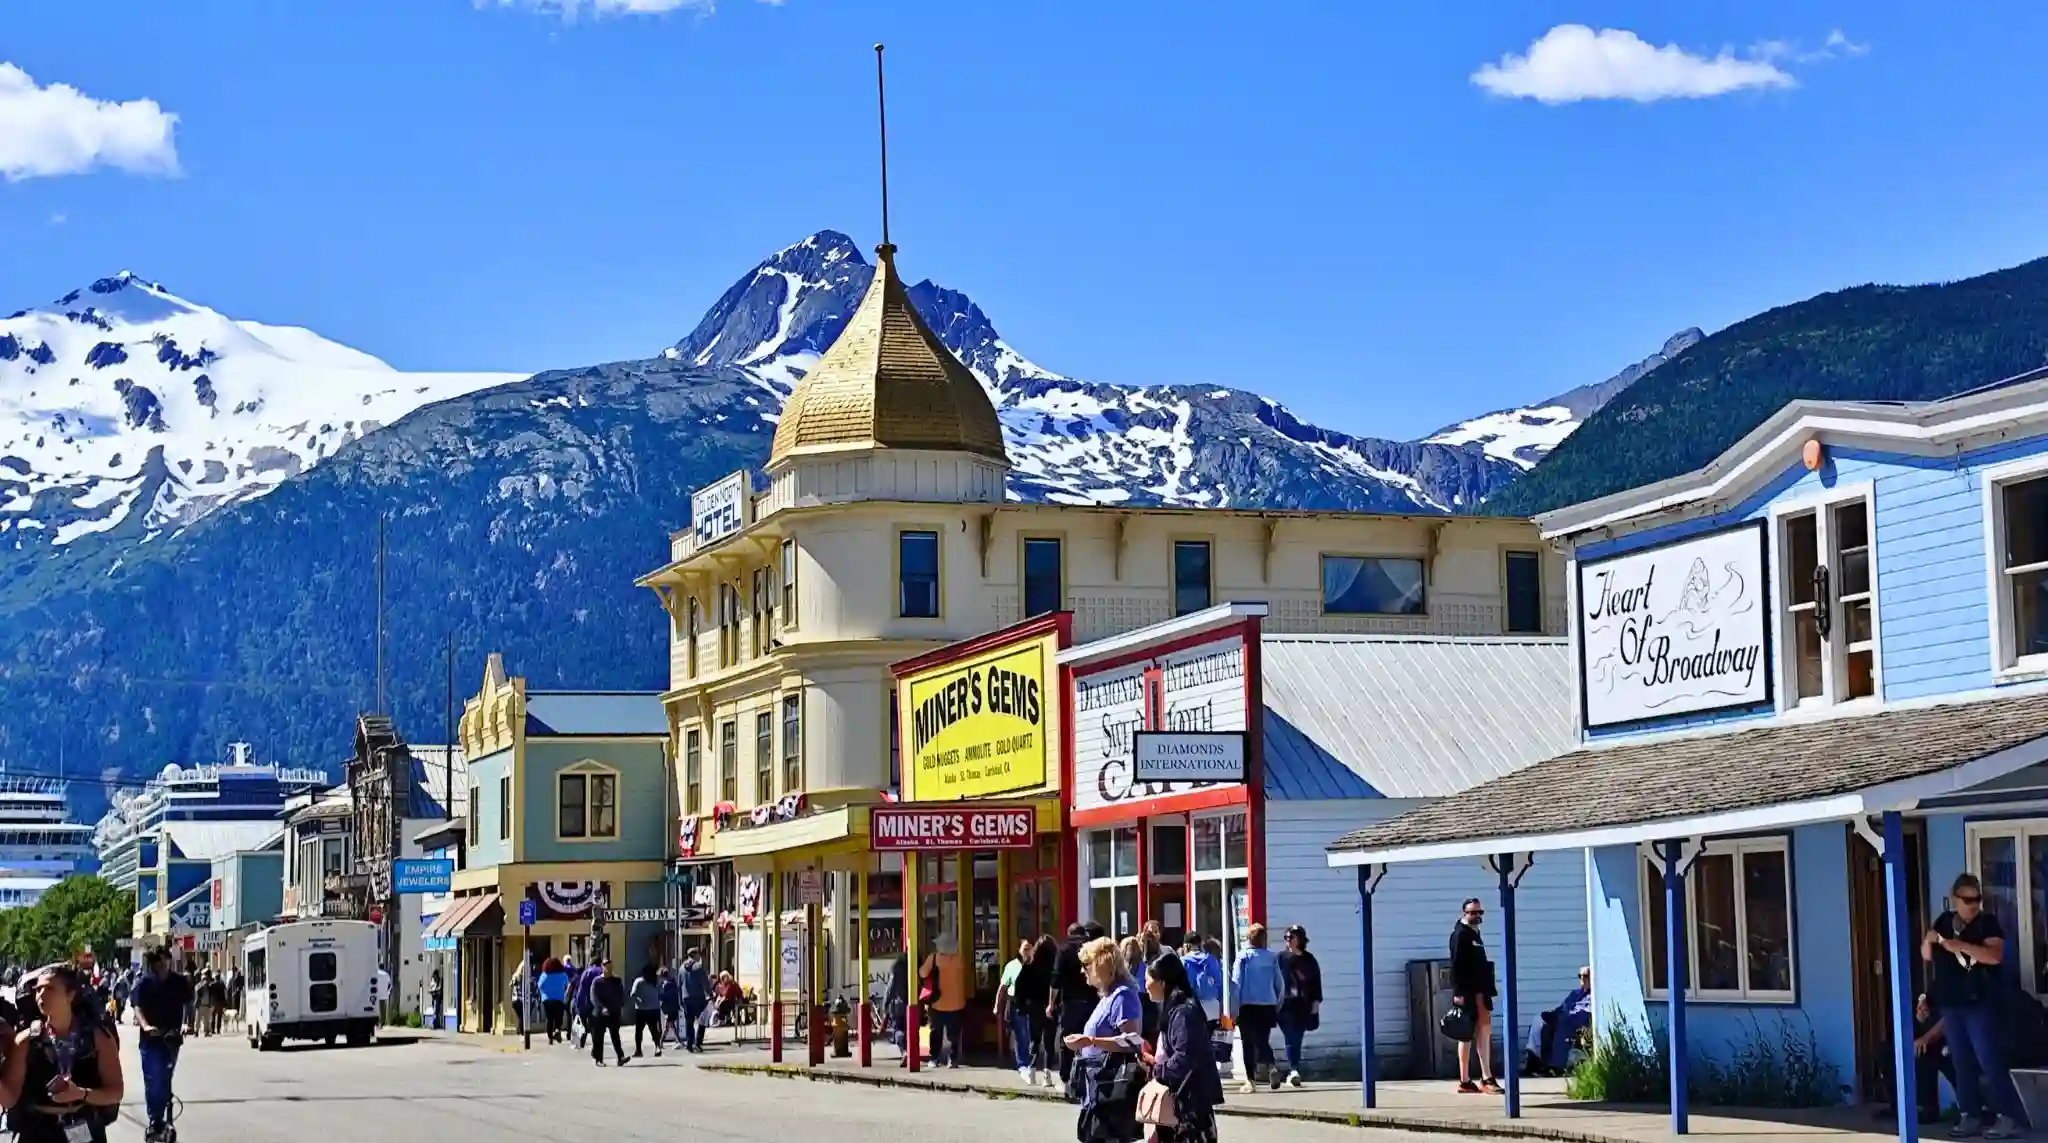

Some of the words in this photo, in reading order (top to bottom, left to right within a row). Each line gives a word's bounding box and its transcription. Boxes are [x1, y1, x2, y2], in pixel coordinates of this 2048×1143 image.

[695, 502, 742, 546] HOTEL
[1589, 563, 1656, 620] Heart
[1620, 614, 1653, 666] Of
[1643, 628, 1760, 688] Broadway
[1079, 673, 1144, 712] DIAMONDS
[1165, 649, 1244, 693] INTERNATIONAL
[915, 667, 982, 756] MINER'S
[987, 665, 1040, 726] GEMS
[923, 753, 936, 770] GOLD
[936, 749, 960, 768] NUGGETS
[965, 742, 992, 762] AMMOLITE
[996, 738, 1011, 756] GOLD
[1011, 732, 1033, 755] QUARTZ
[1140, 759, 1241, 770] INTERNATIONAL
[1157, 744, 1224, 755] DIAMONDS
[878, 814, 964, 838] MINER'S
[970, 813, 1029, 837] GEMS
[397, 876, 450, 887] JEWELERS
[404, 864, 443, 874] EMPIRE
[604, 909, 669, 921] MUSEUM
